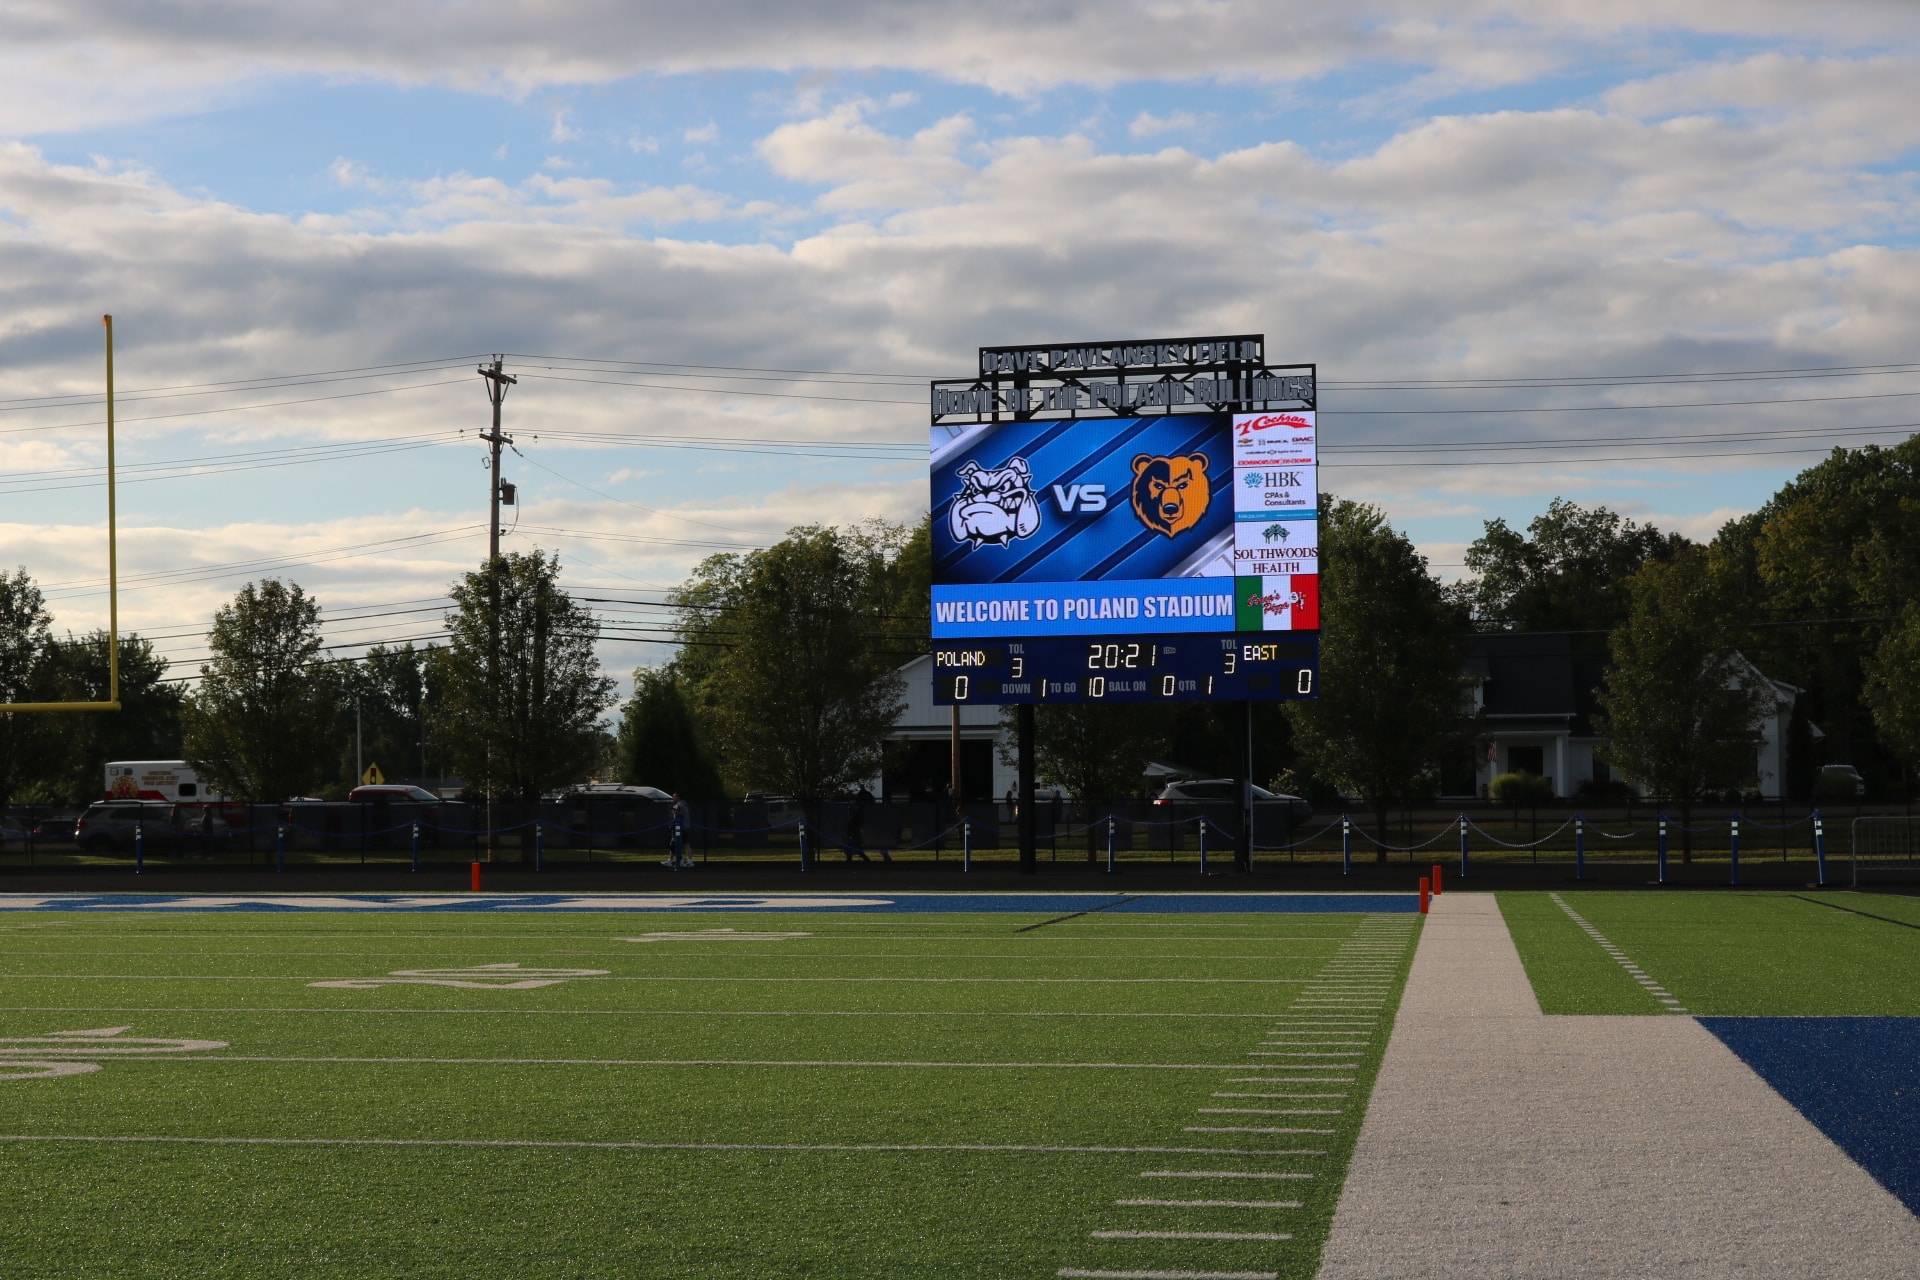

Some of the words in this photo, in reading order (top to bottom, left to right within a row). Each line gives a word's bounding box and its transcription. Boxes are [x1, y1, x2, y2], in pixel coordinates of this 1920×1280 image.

[984, 350, 1043, 372] DAVE
[1050, 343, 1189, 369] PAVLANSKY
[1196, 340, 1256, 363] FIELD
[932, 388, 999, 415] HOME
[1006, 387, 1033, 412] OF
[1040, 386, 1083, 411] THE
[1090, 381, 1186, 409] POLAND
[1193, 376, 1314, 404] BULLDOGS
[1252, 413, 1312, 430] Cochran
[1264, 471, 1302, 488] HBK
[1052, 484, 1107, 512] VS
[1264, 499, 1306, 507] Consultants
[1234, 547, 1318, 560] SOUTHWOODS
[1252, 562, 1300, 574] HEALTH
[935, 600, 1030, 623] WELCOME
[1034, 599, 1059, 621] TO
[1063, 597, 1139, 620] POLAND
[1143, 594, 1233, 619] STADIUM
[1009, 643, 1025, 655] TOL
[1221, 639, 1238, 650] TOL
[1243, 644, 1278, 661] EAST
[936, 651, 986, 667] POLAND
[1088, 643, 1156, 669] 20:21
[1224, 653, 1236, 675] 3
[1011, 657, 1023, 679] 3
[954, 675, 969, 700] 0
[1002, 683, 1031, 694] DOWN
[1042, 678, 1047, 698] 1
[1050, 682, 1062, 693] TO
[1063, 682, 1077, 693] GO
[1088, 676, 1105, 698] 10
[1108, 681, 1131, 692] BALL
[1133, 680, 1147, 691] ON
[1162, 675, 1175, 696] 0
[1178, 680, 1196, 691] QTR
[1208, 675, 1213, 695] 1
[1297, 669, 1312, 694] 0
